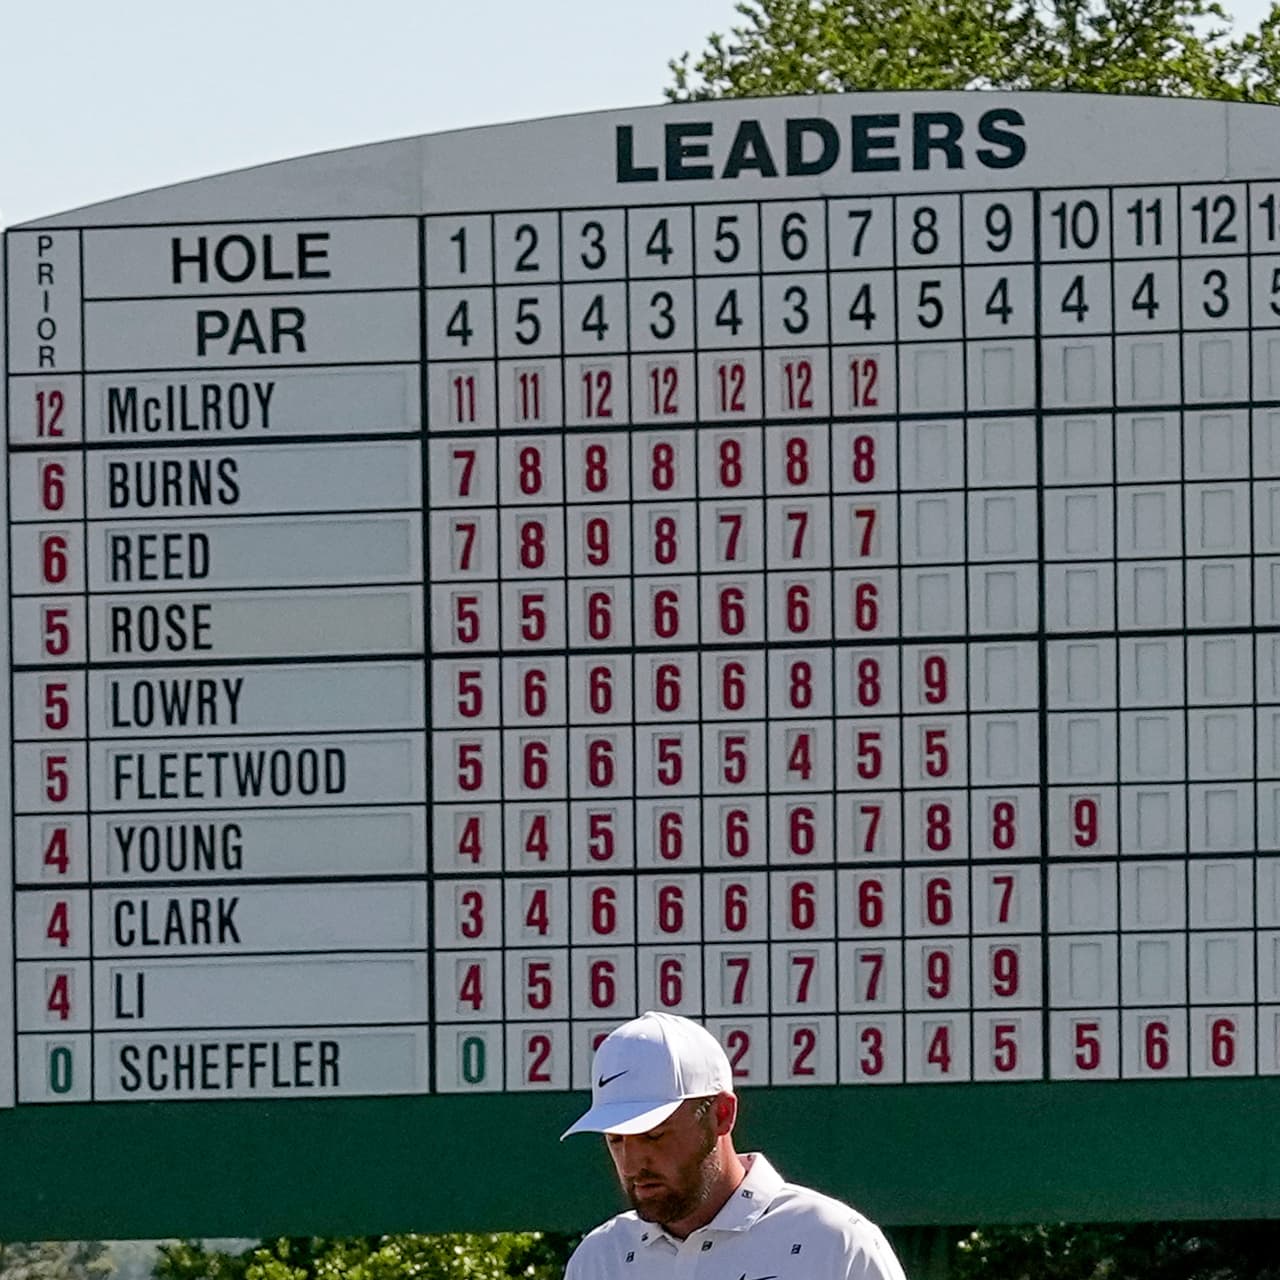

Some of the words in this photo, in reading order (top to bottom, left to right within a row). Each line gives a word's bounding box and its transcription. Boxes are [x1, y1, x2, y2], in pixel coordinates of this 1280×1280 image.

[615, 107, 1027, 184] LEADERS
[171, 232, 331, 285] HOLE
[450, 226, 467, 274] 1
[514, 223, 540, 272] 2
[580, 220, 607, 271] 3
[645, 218, 674, 266] 4
[713, 215, 741, 264] 5
[780, 211, 808, 262] 6
[847, 209, 873, 257] 7
[911, 206, 939, 256] 8
[985, 202, 1013, 253] 9
[1050, 199, 1100, 250] 10
[1126, 198, 1162, 247] 11
[1191, 194, 1238, 244] 12
[36, 233, 57, 369] PRIOR
[196, 306, 307, 357] PAR
[445, 299, 474, 347] 4
[515, 297, 541, 346] 5
[581, 294, 609, 342] 4
[649, 290, 676, 340] 3
[715, 288, 743, 336] 4
[783, 285, 810, 335] 3
[848, 283, 877, 331] 4
[917, 279, 944, 329] 5
[985, 277, 1014, 325] 4
[1061, 274, 1090, 323] 4
[1131, 272, 1160, 320] 4
[1202, 269, 1230, 319] 3
[35, 390, 65, 438] 12
[107, 381, 276, 435] McILROY
[453, 375, 476, 424] 11
[519, 372, 540, 421] 11
[581, 370, 613, 419] 12
[649, 365, 679, 416] 12
[717, 363, 746, 413] 12
[783, 360, 814, 410] 12
[849, 358, 878, 408] 12
[42, 463, 65, 512] 6
[108, 457, 240, 509] BURNS
[452, 449, 476, 497] 7
[519, 446, 542, 496] 8
[585, 444, 608, 494] 8
[651, 442, 675, 491] 8
[719, 438, 742, 488] 8
[785, 437, 809, 486] 8
[852, 434, 875, 484] 8
[42, 535, 67, 584] 6
[111, 532, 210, 583] REED
[454, 522, 477, 571] 7
[520, 520, 545, 570] 8
[586, 517, 610, 567] 9
[654, 516, 677, 565] 8
[718, 514, 743, 562] 7
[786, 511, 809, 560] 7
[853, 508, 876, 557] 7
[44, 609, 70, 656] 5
[111, 603, 213, 654] ROSE
[456, 596, 480, 644] 5
[521, 594, 547, 642] 5
[588, 591, 611, 641] 6
[653, 589, 679, 639] 6
[718, 587, 746, 636] 6
[786, 584, 810, 634] 6
[855, 582, 879, 632] 6
[44, 683, 69, 731] 5
[111, 677, 244, 729] LOWRY
[457, 670, 483, 718] 5
[524, 669, 547, 718] 6
[589, 666, 613, 715] 6
[655, 663, 681, 713] 6
[722, 662, 746, 711] 6
[789, 660, 813, 710] 8
[857, 657, 882, 708] 8
[923, 655, 947, 705] 9
[45, 755, 69, 803] 5
[114, 747, 346, 801] FLEETWOOD
[458, 743, 483, 792] 5
[522, 741, 549, 791] 6
[588, 739, 614, 789] 6
[657, 738, 683, 787] 5
[723, 735, 747, 785] 5
[786, 733, 812, 781] 4
[856, 731, 882, 780] 5
[925, 729, 949, 778] 5
[43, 827, 70, 875] 4
[113, 823, 243, 874] YOUNG
[458, 817, 482, 865] 4
[525, 814, 549, 862] 4
[588, 813, 614, 862] 5
[659, 812, 683, 861] 6
[726, 809, 749, 859] 6
[789, 806, 815, 856] 6
[859, 805, 882, 854] 7
[926, 803, 952, 852] 8
[992, 801, 1015, 851] 8
[1074, 798, 1098, 849] 9
[46, 901, 70, 948] 4
[114, 896, 241, 948] CLARK
[460, 890, 484, 940] 3
[525, 889, 550, 936] 4
[591, 886, 617, 936] 6
[658, 885, 684, 934] 6
[724, 883, 748, 933] 6
[790, 881, 815, 931] 6
[858, 879, 884, 929] 6
[926, 877, 953, 927] 6
[992, 875, 1014, 924] 7
[46, 974, 71, 1021] 4
[115, 972, 145, 1020] LI
[458, 963, 484, 1011] 4
[527, 962, 552, 1011] 5
[589, 960, 615, 1009] 6
[659, 958, 683, 1008] 6
[726, 957, 751, 1005] 7
[791, 956, 815, 1004] 7
[859, 953, 884, 1002] 7
[926, 950, 950, 1000] 9
[991, 947, 1020, 998] 9
[49, 1046, 73, 1094] 0
[119, 1040, 340, 1093] SCHEFFLER
[462, 1036, 486, 1085] 0
[527, 1035, 552, 1083] 2
[726, 1029, 750, 1078] 2
[791, 1027, 816, 1076] 2
[860, 1027, 884, 1077] 3
[927, 1026, 951, 1074] 4
[993, 1024, 1017, 1073] 5
[1075, 1022, 1101, 1071] 5
[1145, 1021, 1169, 1071] 6
[1211, 1018, 1236, 1068] 6
